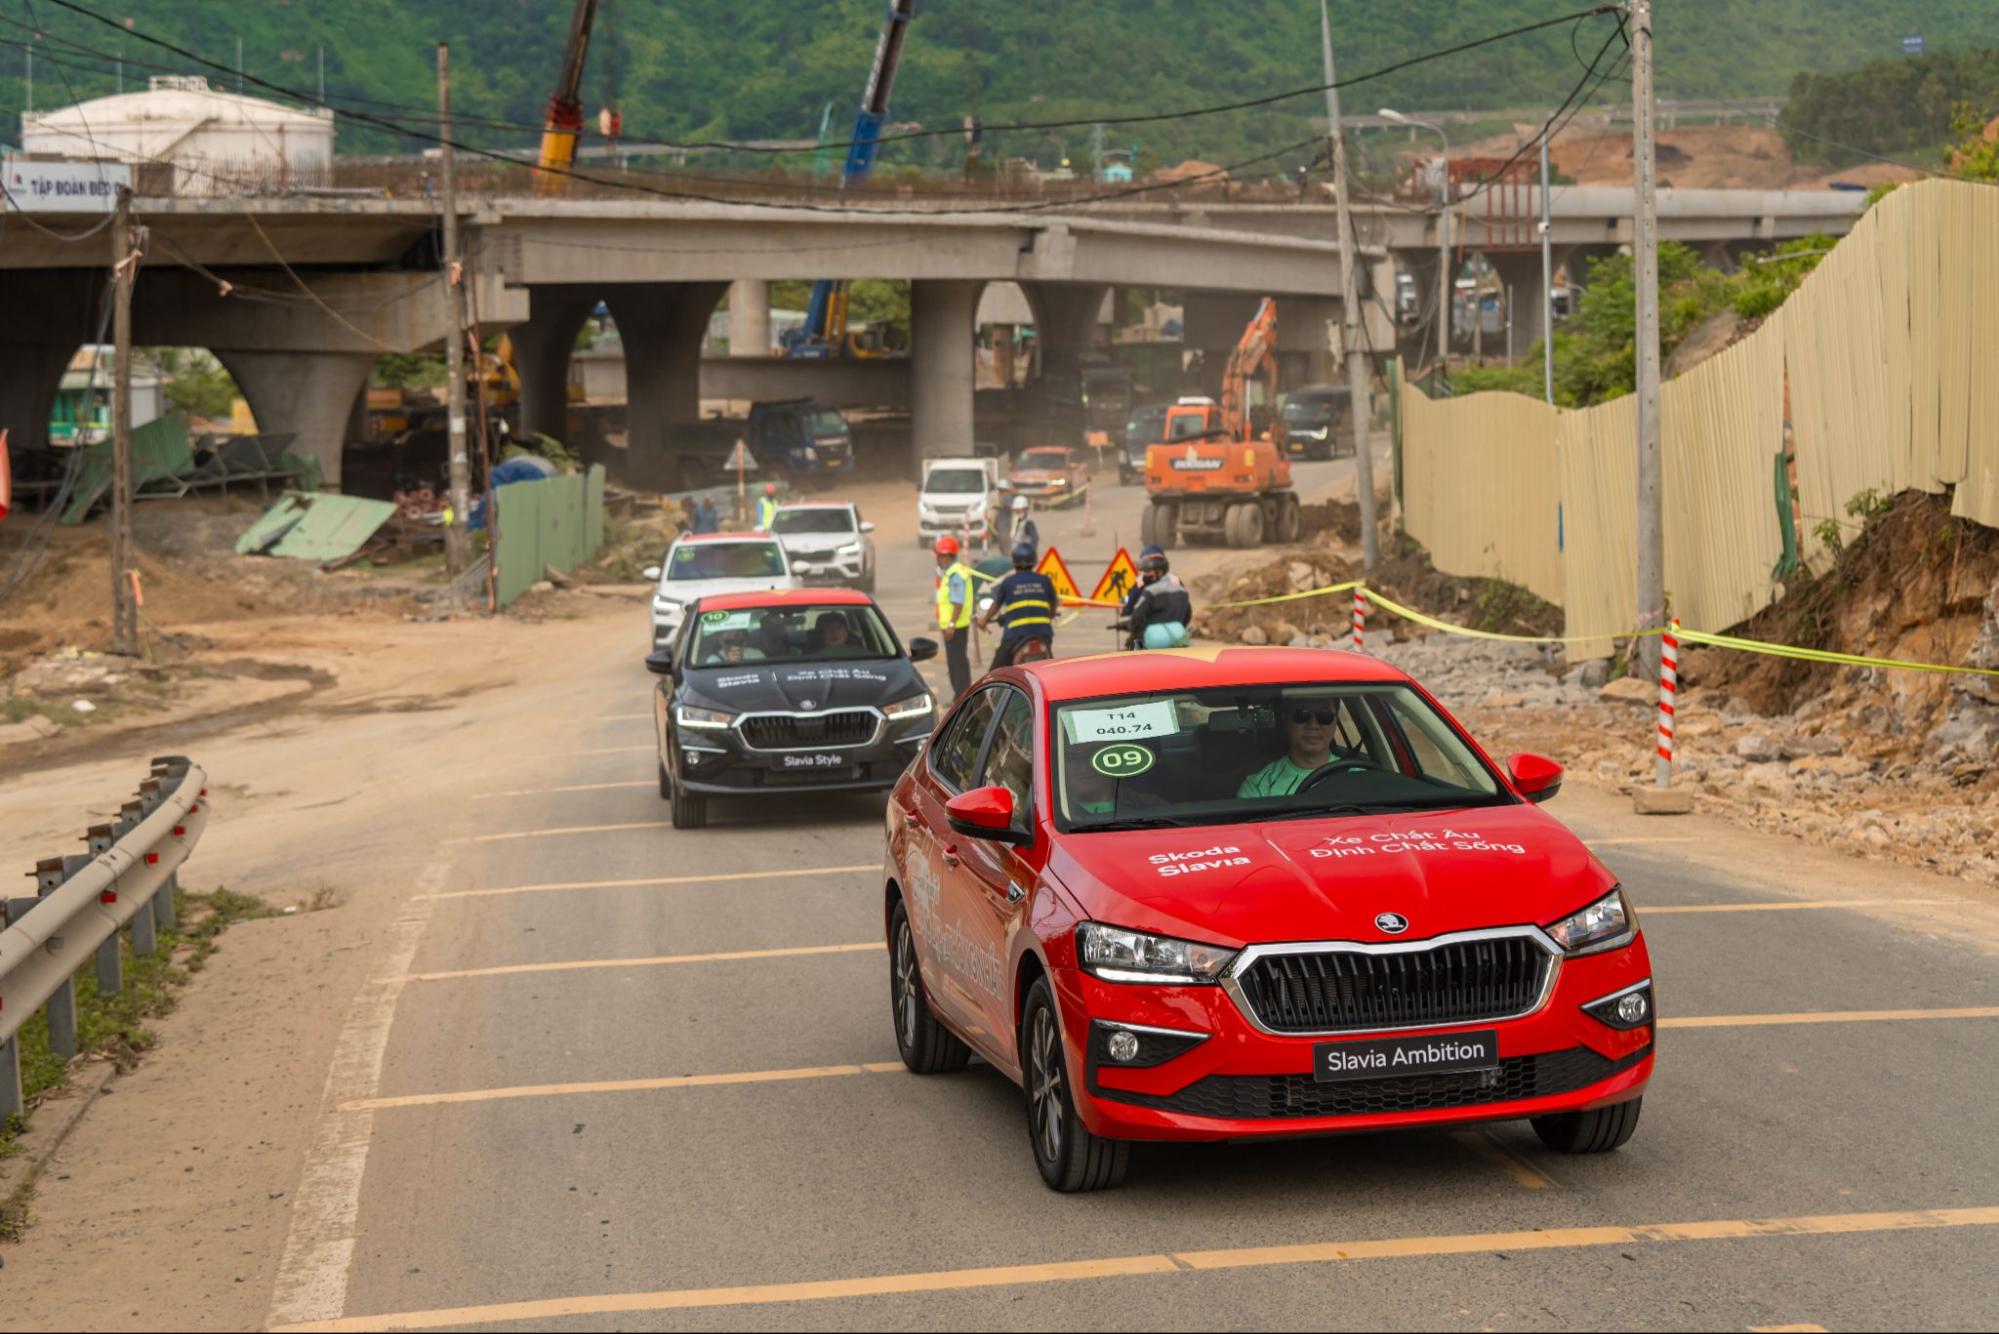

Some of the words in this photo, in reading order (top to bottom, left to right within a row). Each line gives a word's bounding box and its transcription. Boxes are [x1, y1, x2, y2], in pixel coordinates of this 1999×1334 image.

[1107, 712, 1136, 720] T14
[1096, 723, 1153, 735] 040.74
[783, 754, 814, 767] Slavia
[815, 753, 842, 768] Style
[1102, 750, 1142, 768] 09
[1323, 836, 1363, 845] Xe
[1453, 840, 1526, 854] Sống
[1148, 846, 1241, 864] Skoda
[1157, 856, 1251, 877] Slavia
[1327, 1049, 1387, 1071] Slavia
[1391, 1041, 1485, 1067] Ambition
